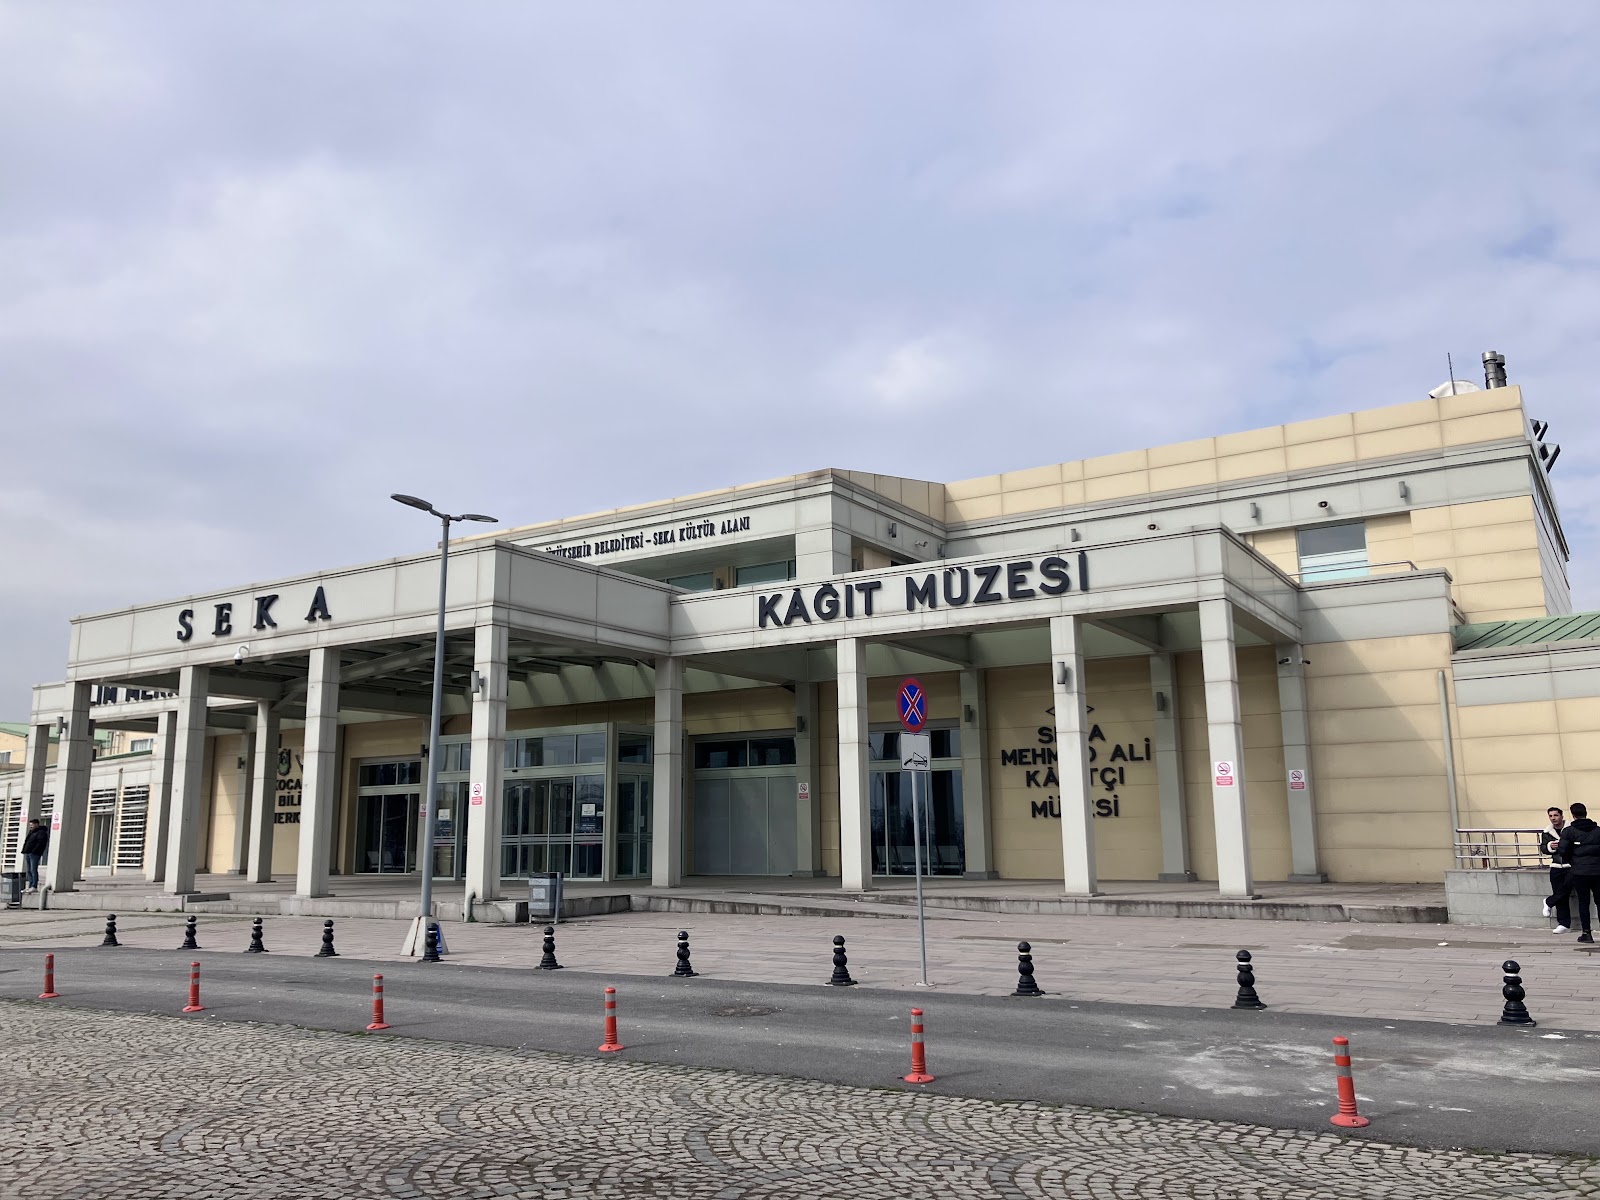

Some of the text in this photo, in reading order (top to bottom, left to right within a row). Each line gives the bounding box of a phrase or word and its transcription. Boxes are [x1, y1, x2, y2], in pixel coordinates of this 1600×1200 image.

[594, 531, 644, 555] BELEDİYESİ
[653, 529, 676, 546] SEKA
[679, 519, 716, 541] KÜLTÜR
[720, 516, 750, 535] ALANI
[905, 549, 1090, 611] MÜZESİ
[176, 585, 332, 642] SEKA
[1038, 724, 1106, 744] SA
[1109, 737, 1151, 762] ALİ
[1026, 766, 1125, 791] KÂTÇI
[1031, 794, 1119, 819] MÜSİ
